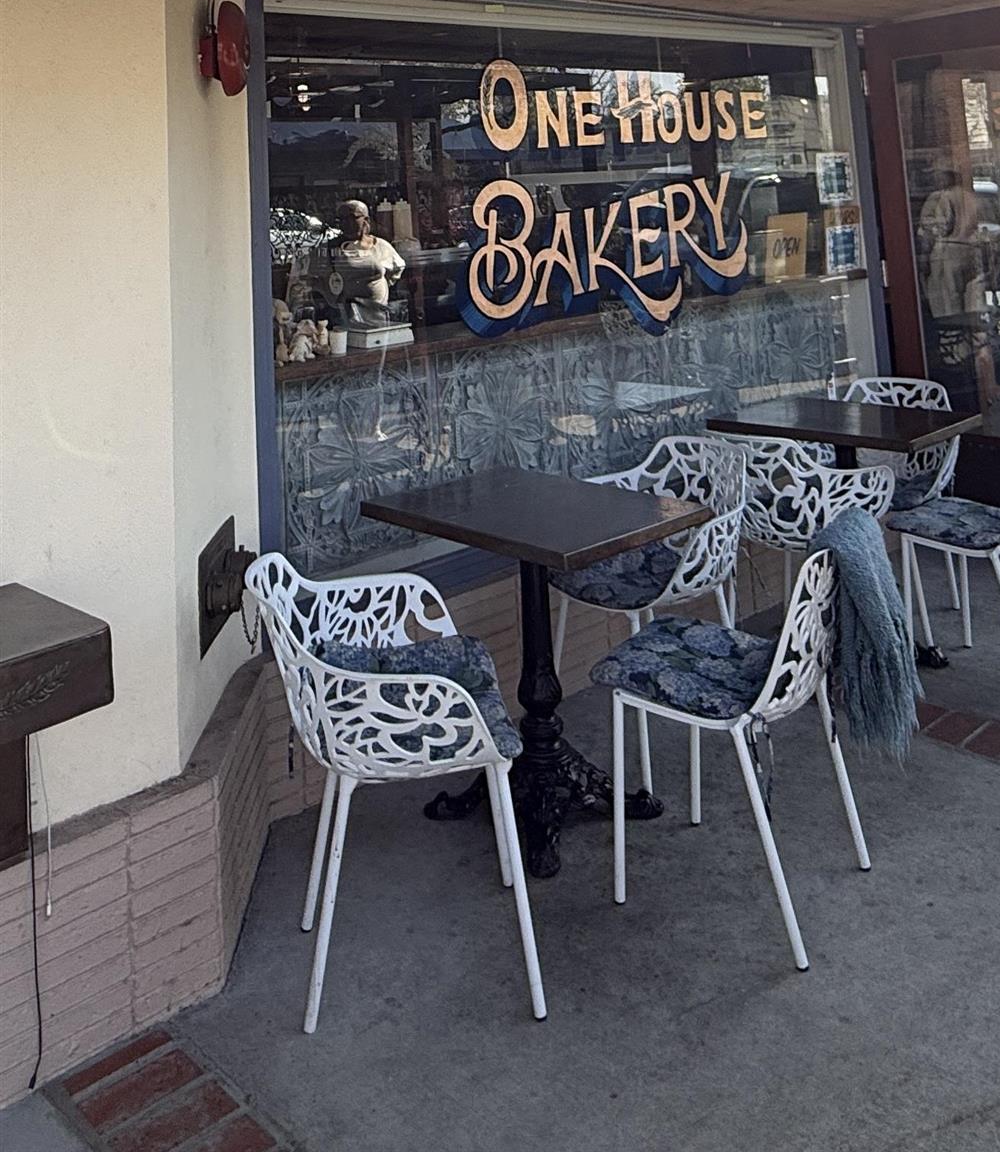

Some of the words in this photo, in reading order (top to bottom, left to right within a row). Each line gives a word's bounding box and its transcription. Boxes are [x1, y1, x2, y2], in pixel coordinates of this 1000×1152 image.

[480, 59, 605, 151] ONE
[610, 69, 767, 144] HOUSE
[468, 170, 748, 323] BAKERY
[772, 236, 801, 260] OPEN
